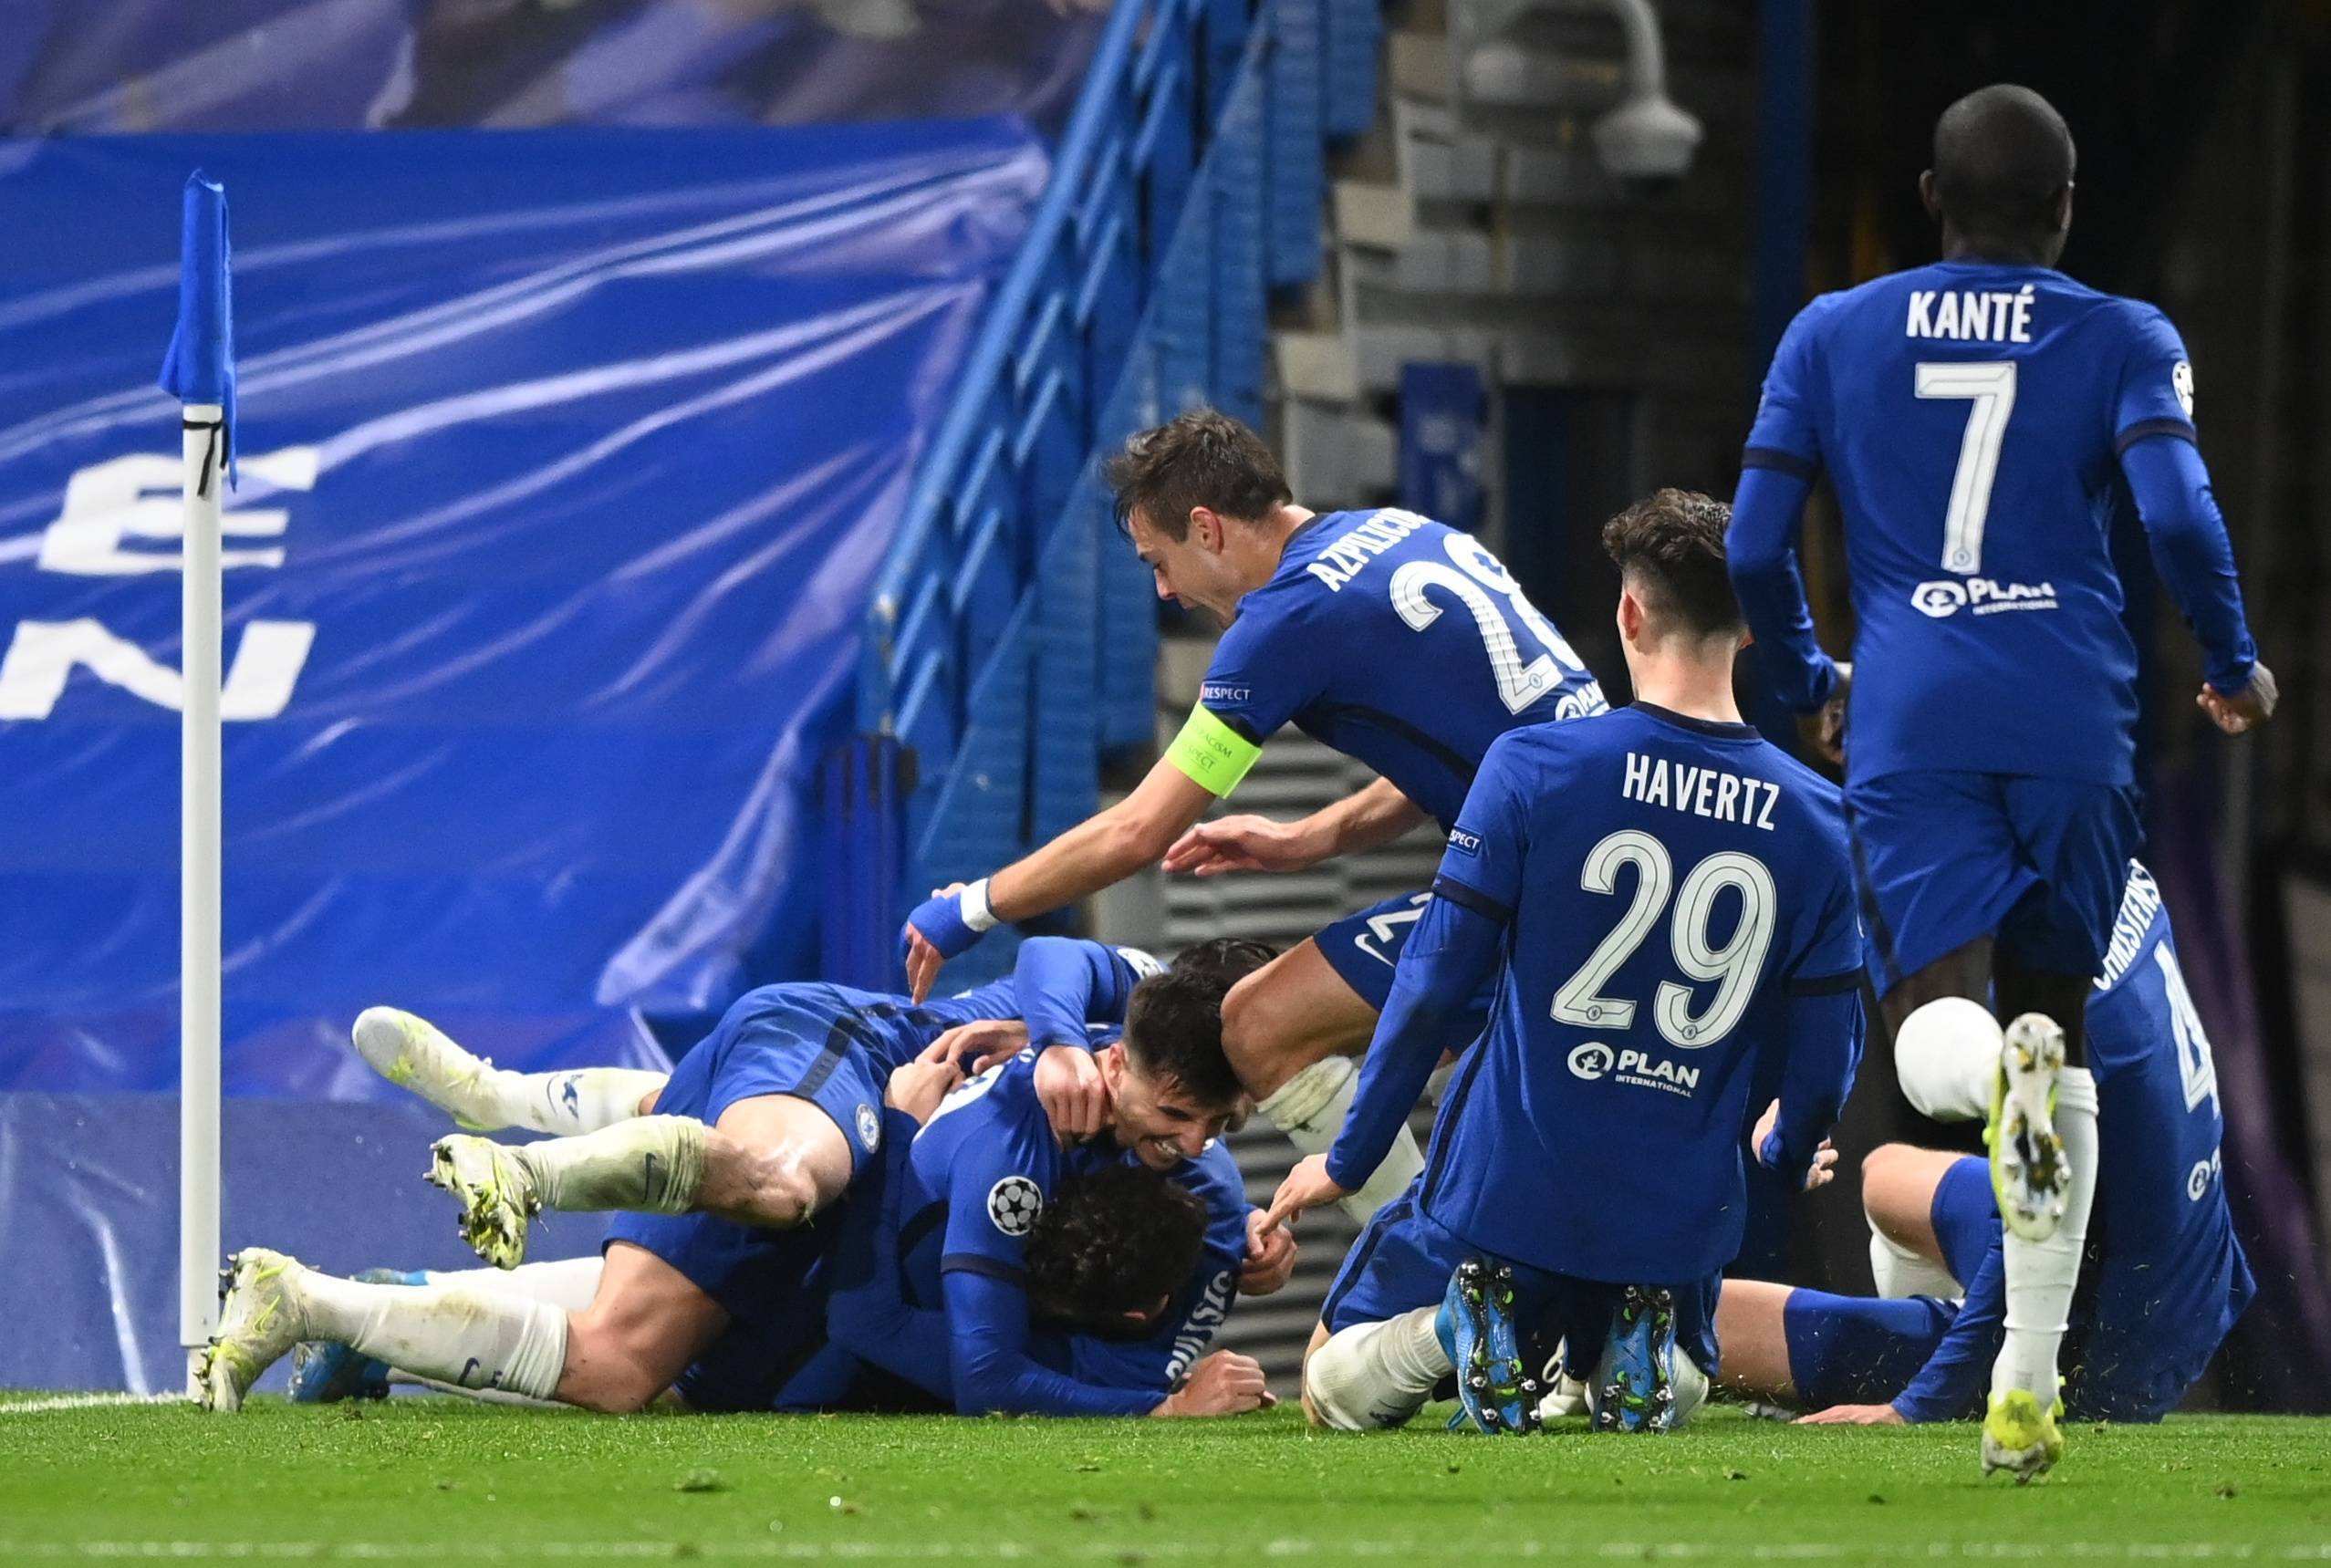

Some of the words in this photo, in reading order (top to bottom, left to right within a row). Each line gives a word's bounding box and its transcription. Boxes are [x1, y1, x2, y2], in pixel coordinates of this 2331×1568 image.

[1906, 285, 2034, 343] KANTÉ
[1915, 361, 2017, 574] 7
[1203, 687, 1251, 701] RESPECT
[1622, 752, 1780, 831] HAVERTZ
[1448, 829, 1480, 849] SPECT
[1550, 829, 1777, 1048] 29
[1615, 1075, 1692, 1097] INTERNATIONAL
[1617, 1049, 1701, 1088] PLAN
